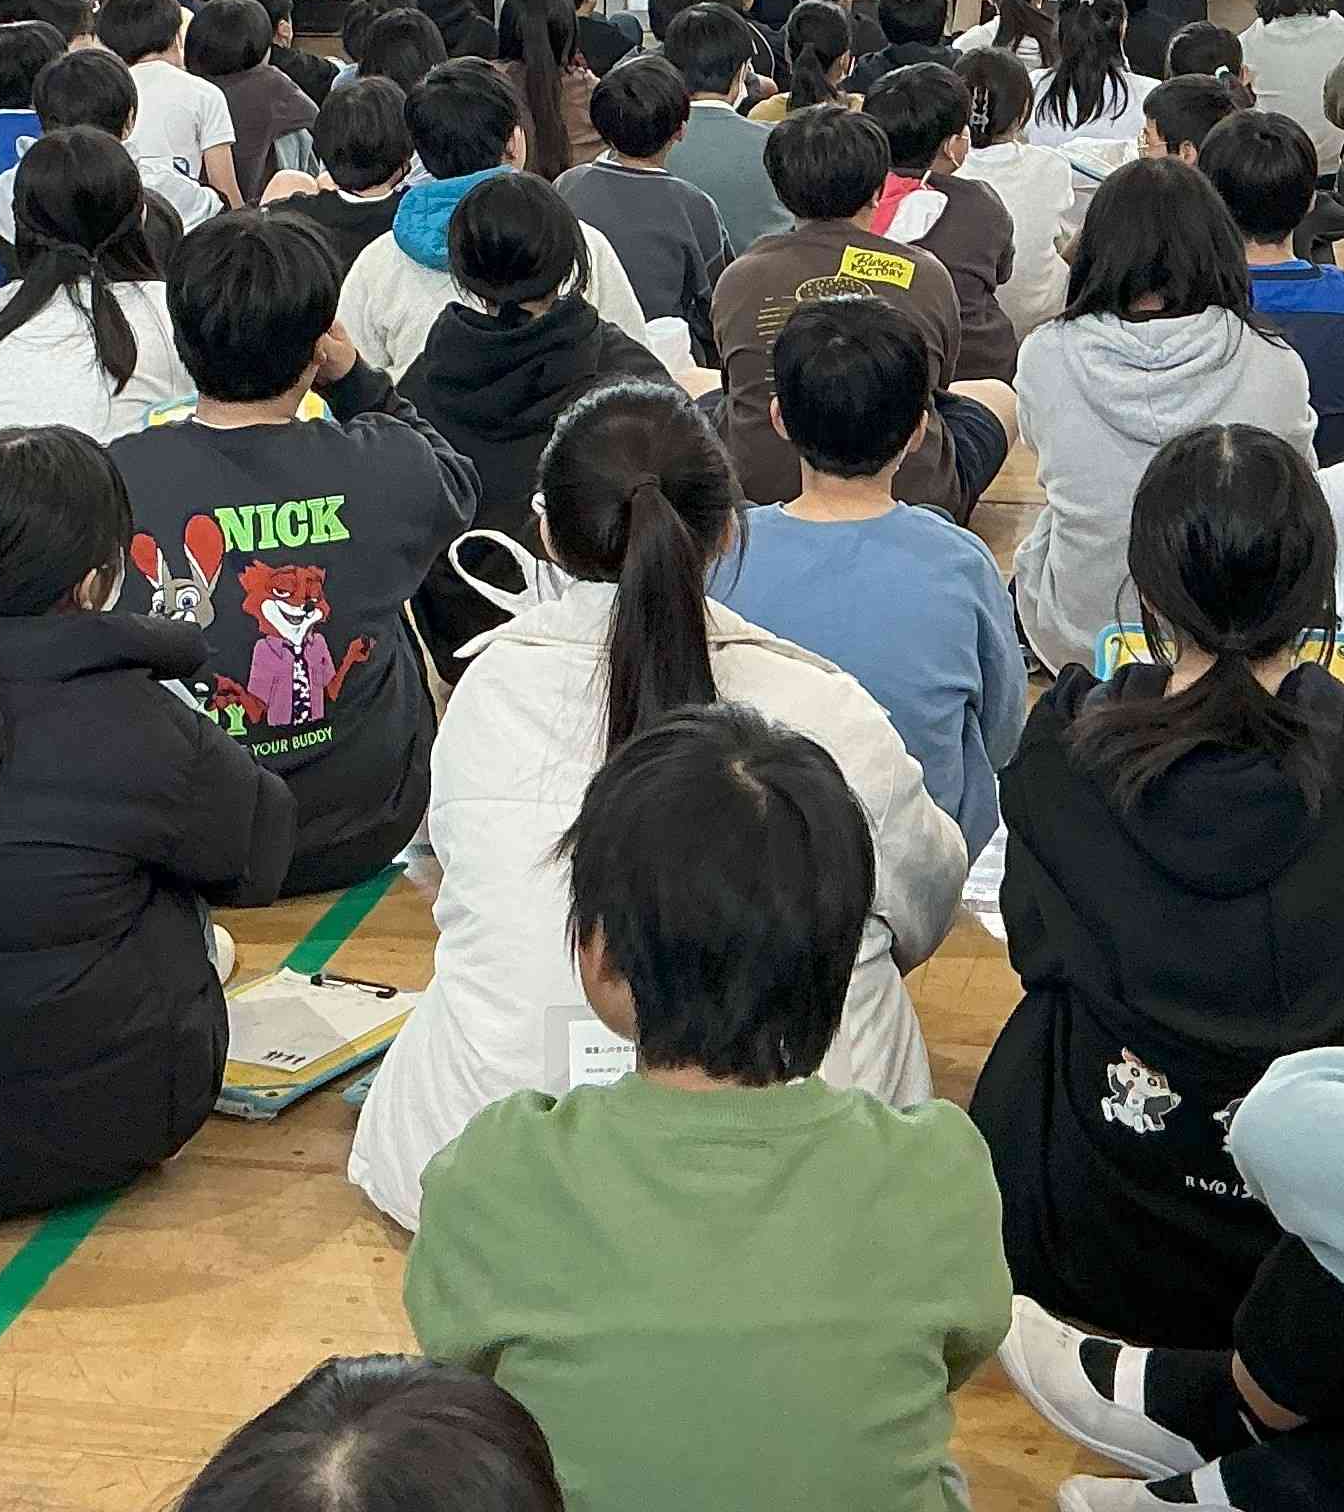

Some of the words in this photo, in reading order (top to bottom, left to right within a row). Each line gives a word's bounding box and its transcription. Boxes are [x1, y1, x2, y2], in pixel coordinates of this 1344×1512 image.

[850, 262, 904, 279] FACTORY
[213, 494, 351, 552] NICK
[251, 737, 289, 756] YOUR
[291, 726, 334, 750] BUDDY
